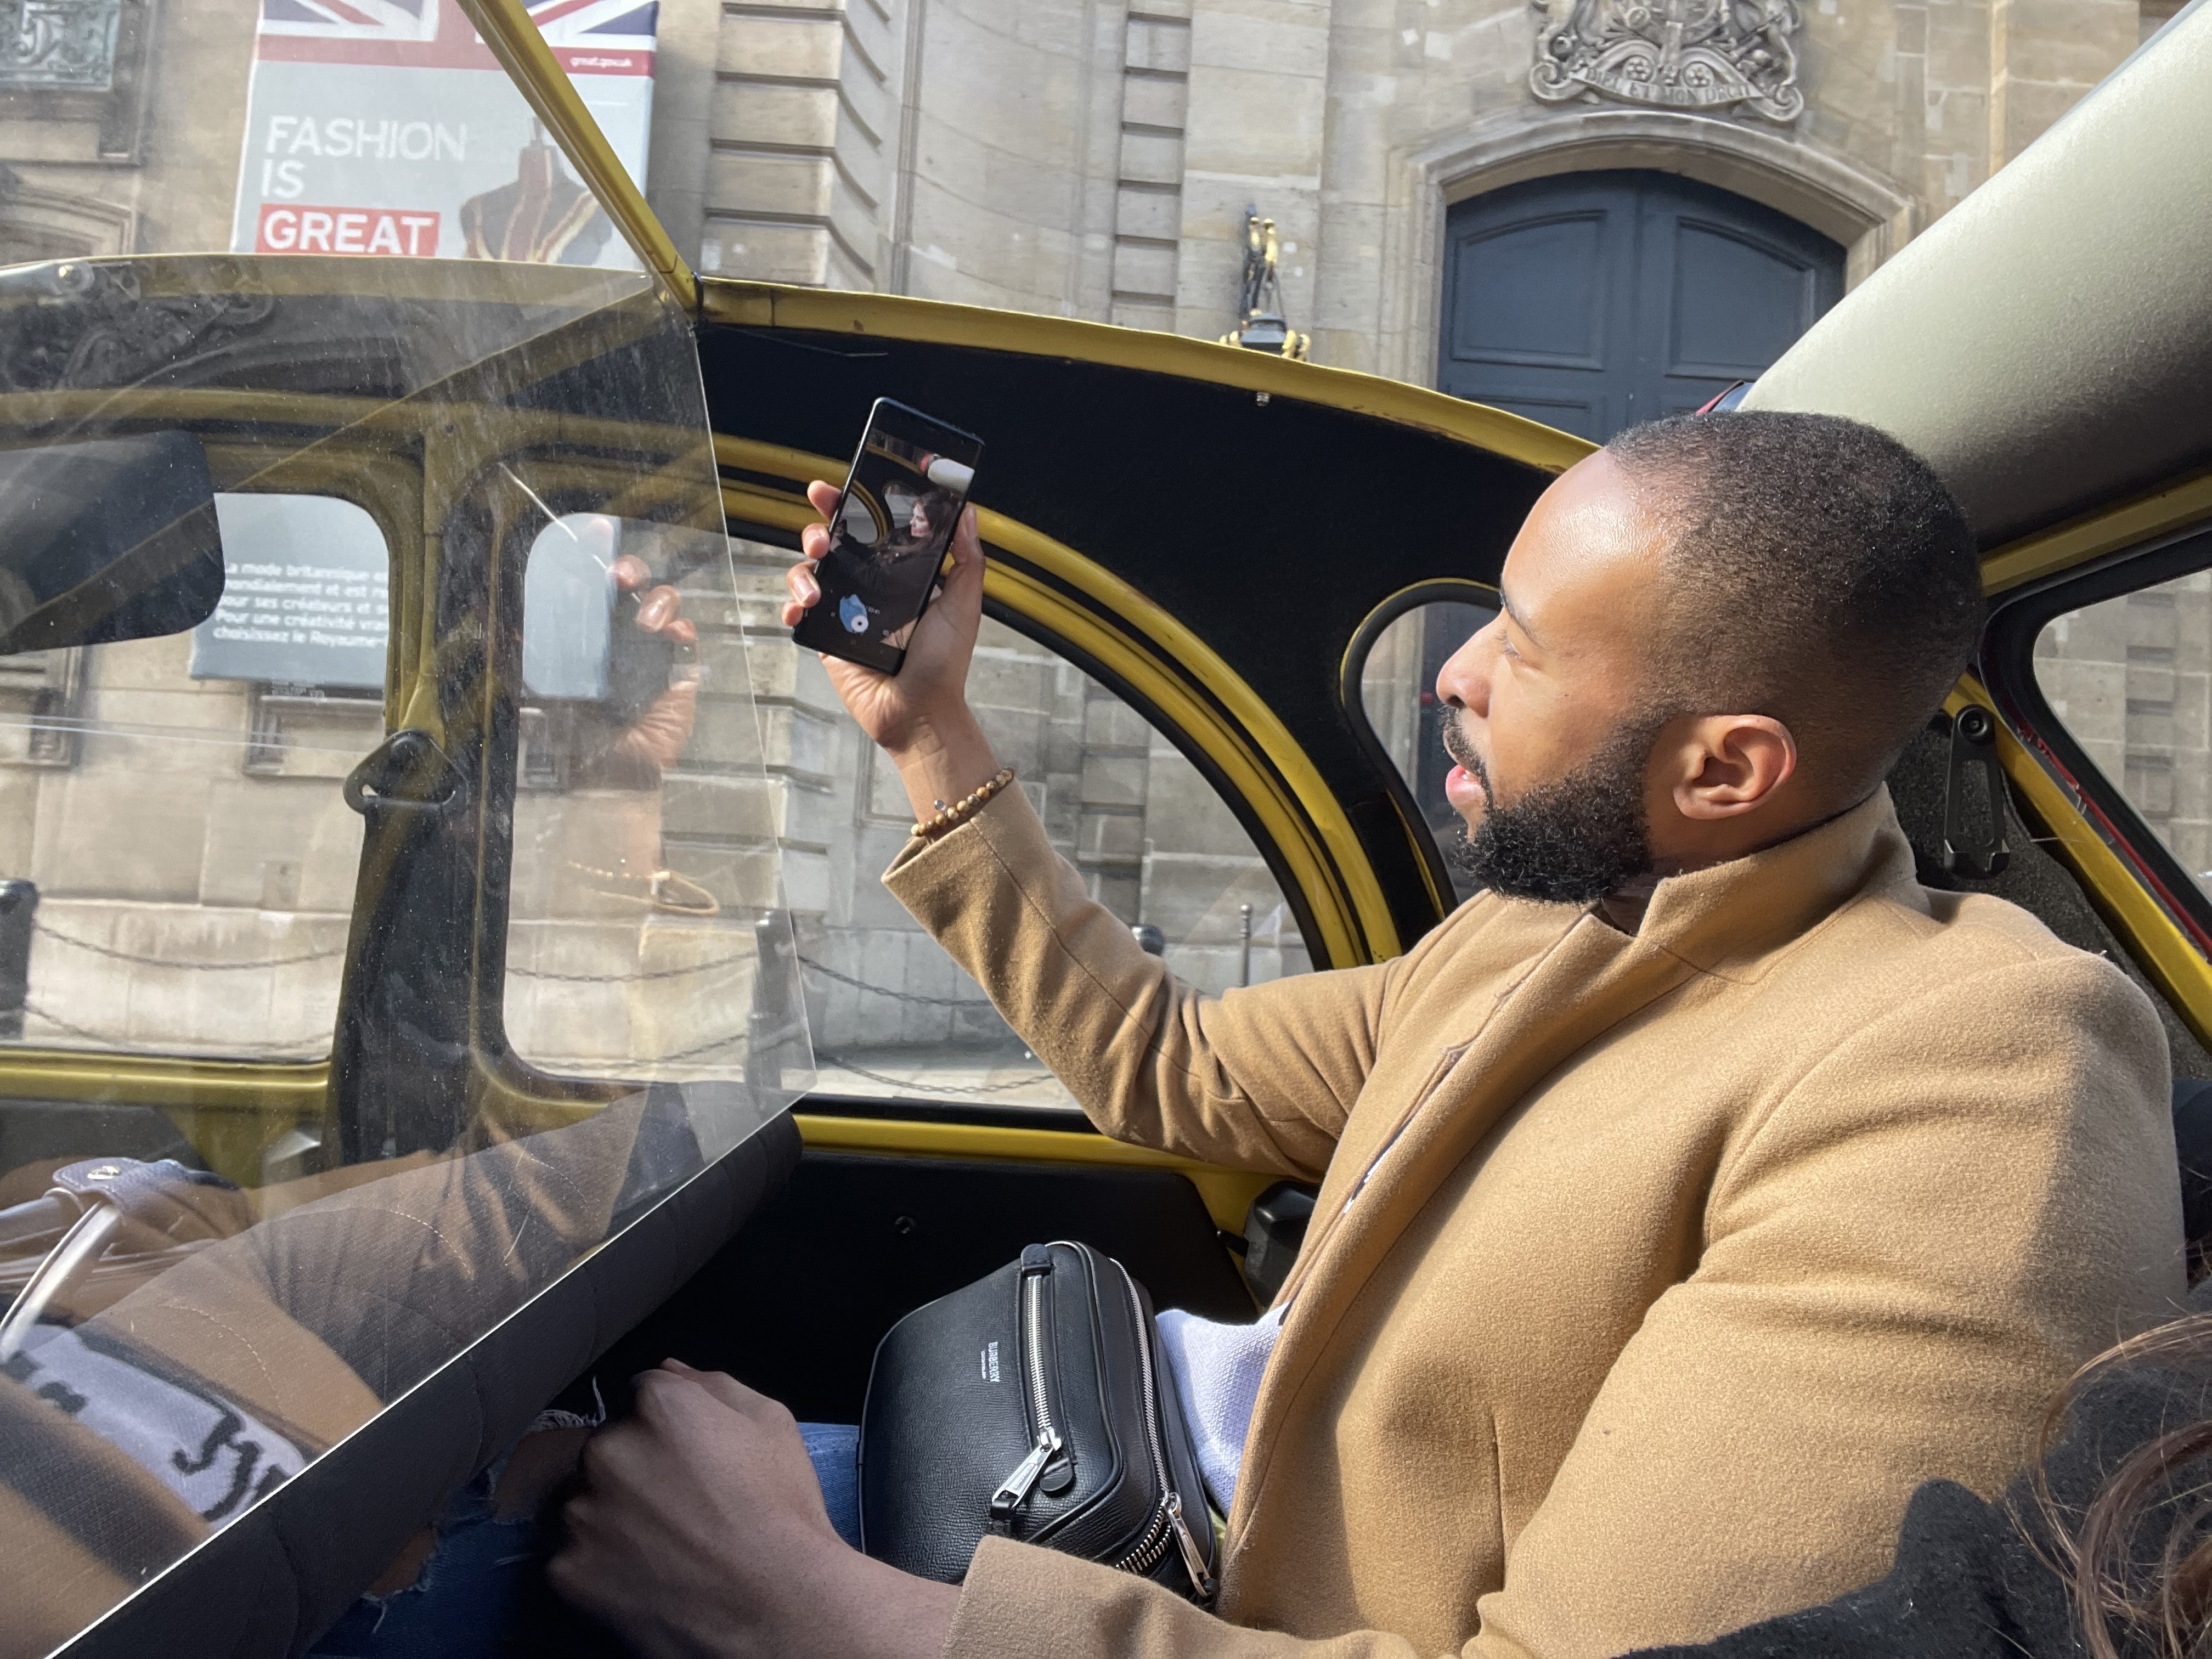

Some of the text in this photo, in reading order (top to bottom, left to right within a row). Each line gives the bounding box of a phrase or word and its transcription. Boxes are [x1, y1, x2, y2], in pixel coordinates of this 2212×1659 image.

[264, 115, 468, 161] FASHION
[260, 159, 306, 199] IS
[264, 210, 435, 255] GREAT
[988, 1341, 1001, 1383] BURBERRY
